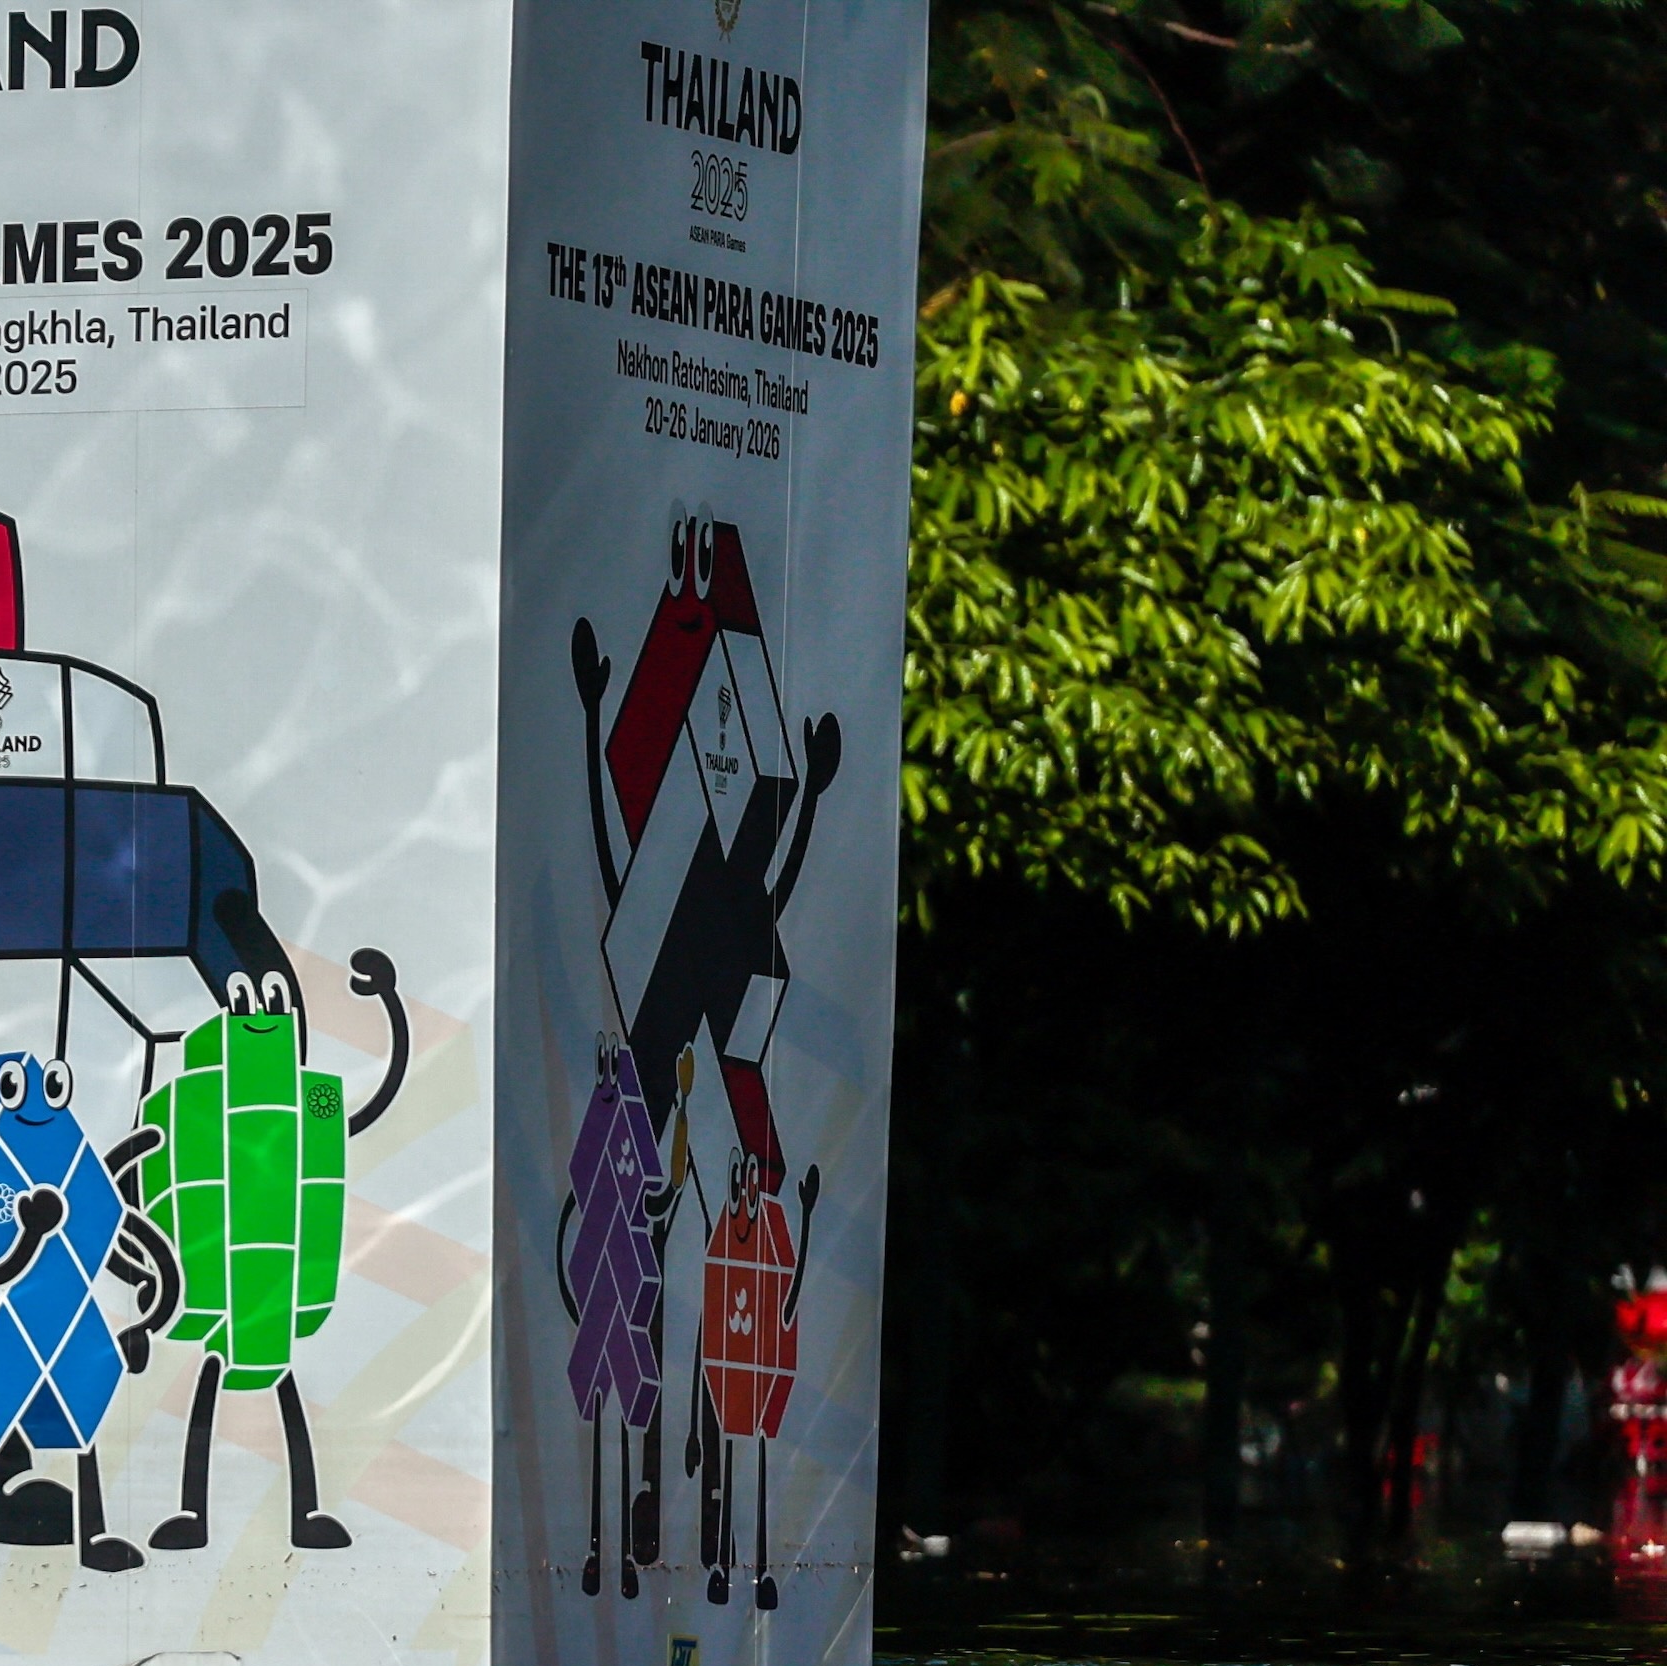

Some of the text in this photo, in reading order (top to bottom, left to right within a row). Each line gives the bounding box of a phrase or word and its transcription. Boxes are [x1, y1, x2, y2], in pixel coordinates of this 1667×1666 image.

[641, 41, 802, 155] THAILAND
[690, 150, 748, 222] 2025
[165, 213, 333, 280] 2025
[127, 302, 290, 342] Thailand
[547, 242, 879, 369] THE 13th ASEAN PARA GAMES 2025
[617, 338, 809, 415] Nakhon Ratchasima, Thailand
[645, 396, 780, 460] 20-26 January 2026
[705, 752, 739, 775] THAILAND
